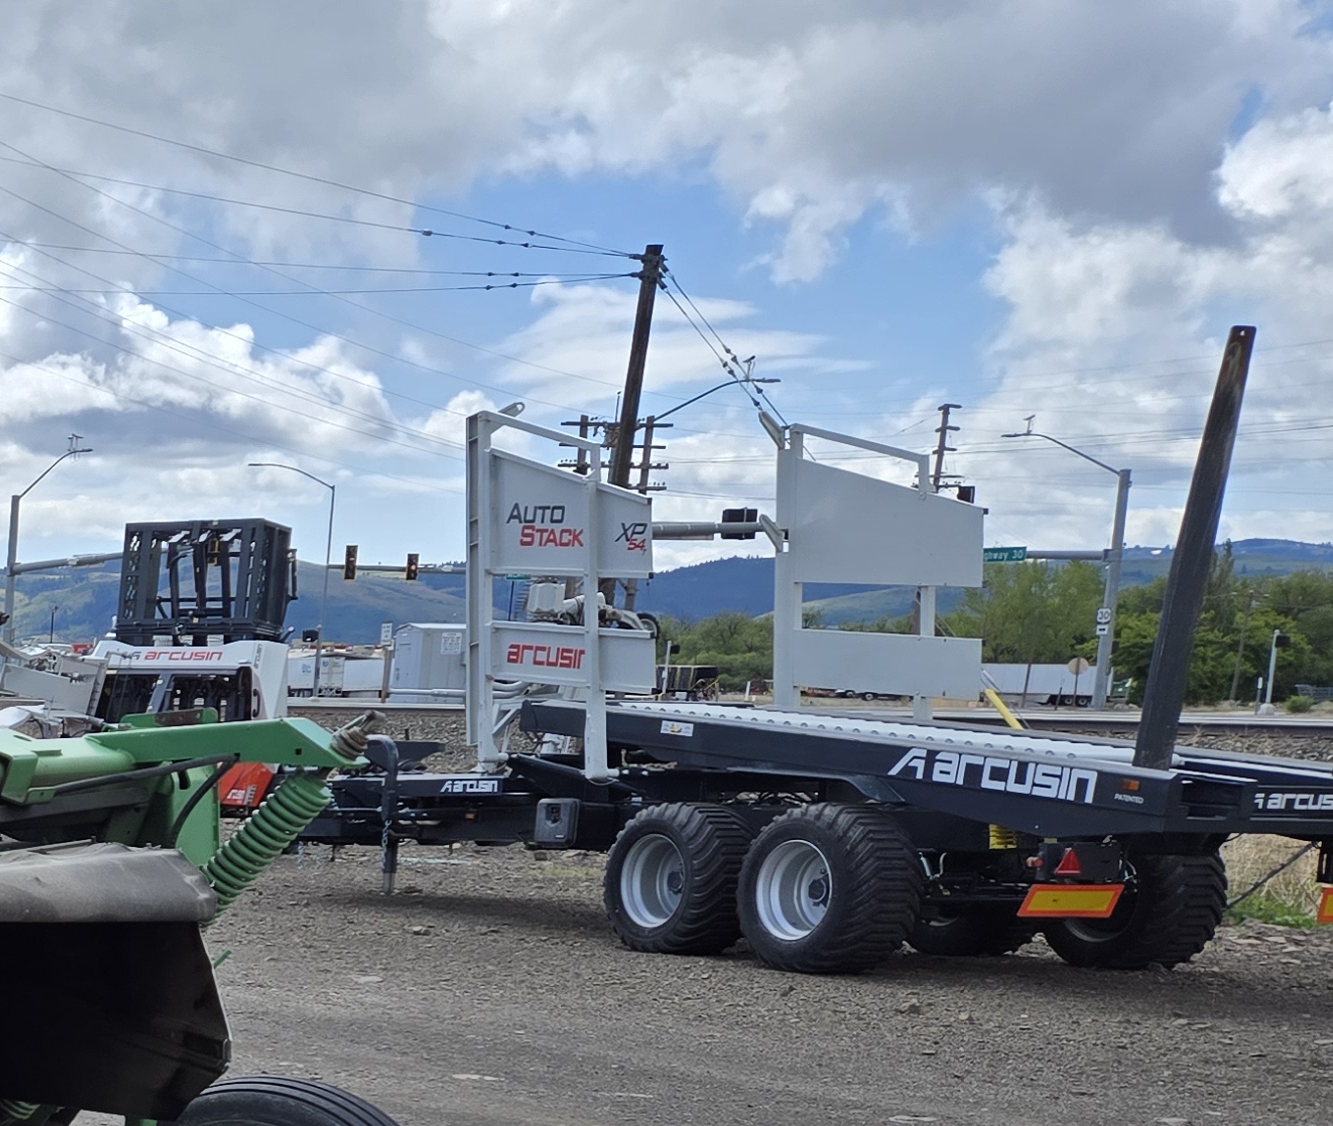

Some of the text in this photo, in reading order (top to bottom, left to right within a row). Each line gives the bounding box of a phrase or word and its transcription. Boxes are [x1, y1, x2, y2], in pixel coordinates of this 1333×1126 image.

[506, 503, 565, 524] AUTO
[519, 525, 584, 547] STACK
[614, 522, 648, 543] XP
[984, 549, 1023, 562] ghway 30
[1098, 610, 1110, 620] 30
[1266, 793, 1333, 810] arcus
